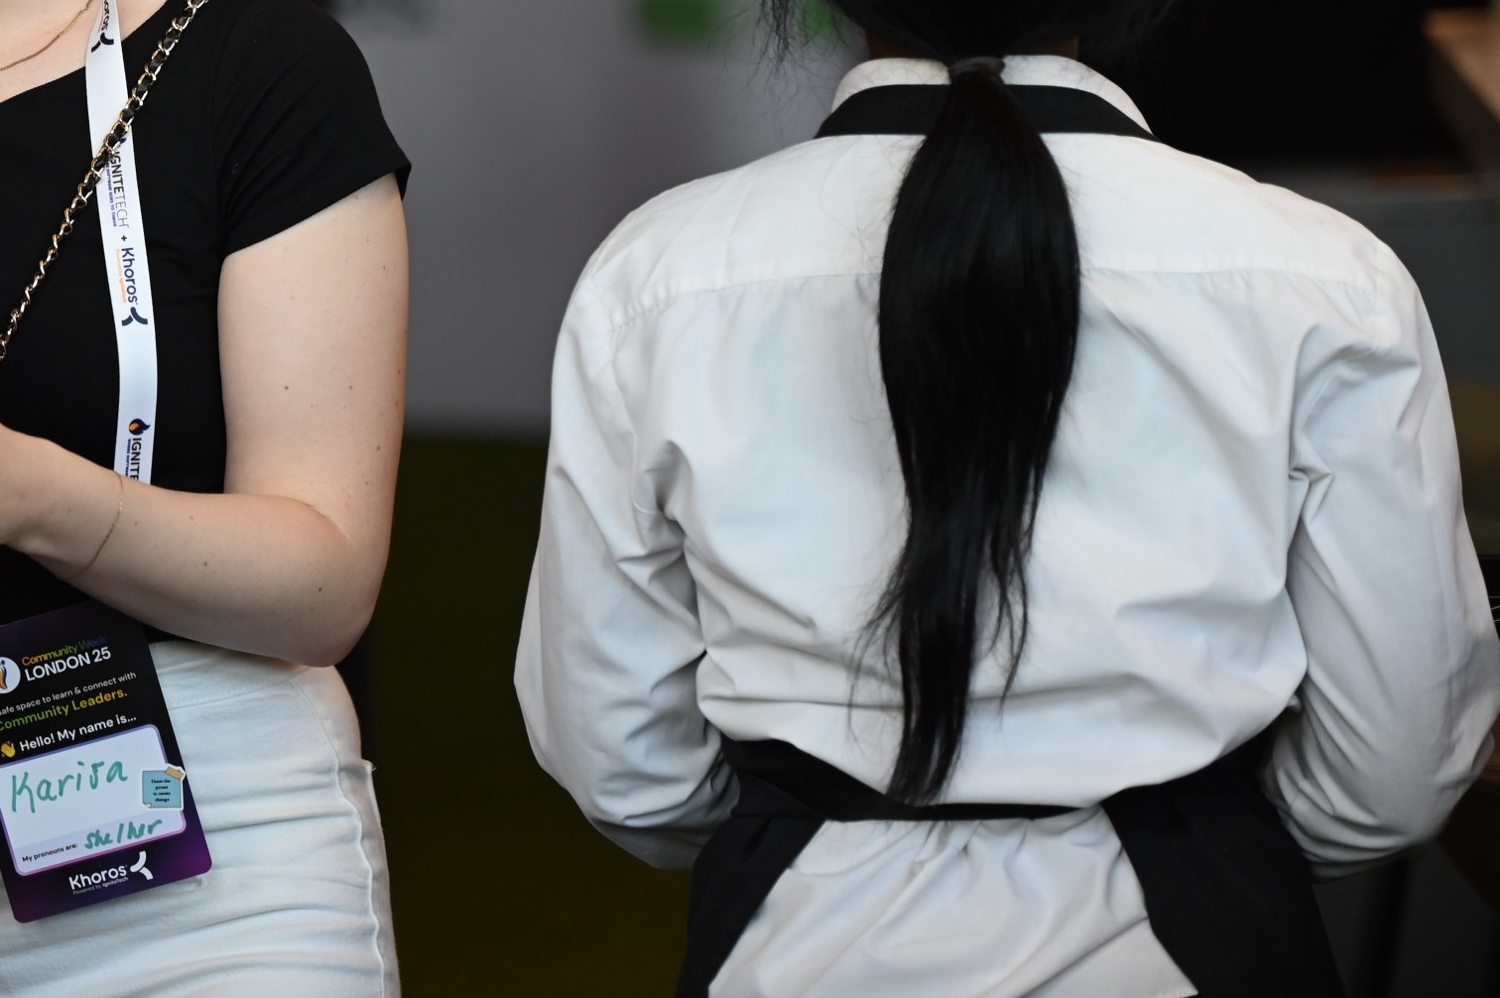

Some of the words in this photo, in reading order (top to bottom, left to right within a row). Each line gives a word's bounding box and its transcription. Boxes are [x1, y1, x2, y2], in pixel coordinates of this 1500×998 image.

[121, 247, 138, 304] Khoros
[22, 643, 78, 666] Community
[24, 651, 91, 681] LONDON
[92, 646, 112, 663] 25
[16, 699, 41, 712] space
[42, 695, 52, 704] to
[52, 689, 74, 701] learn
[74, 686, 81, 695] &
[82, 677, 117, 693] connect
[118, 671, 137, 683] with
[71, 689, 128, 712] Leaders.
[19, 731, 56, 752] Hello!
[57, 728, 76, 742] My
[78, 718, 114, 736] name
[115, 714, 137, 726] is...
[22, 855, 33, 863] My
[33, 847, 65, 861] pronouns
[69, 865, 128, 890] Khoros
